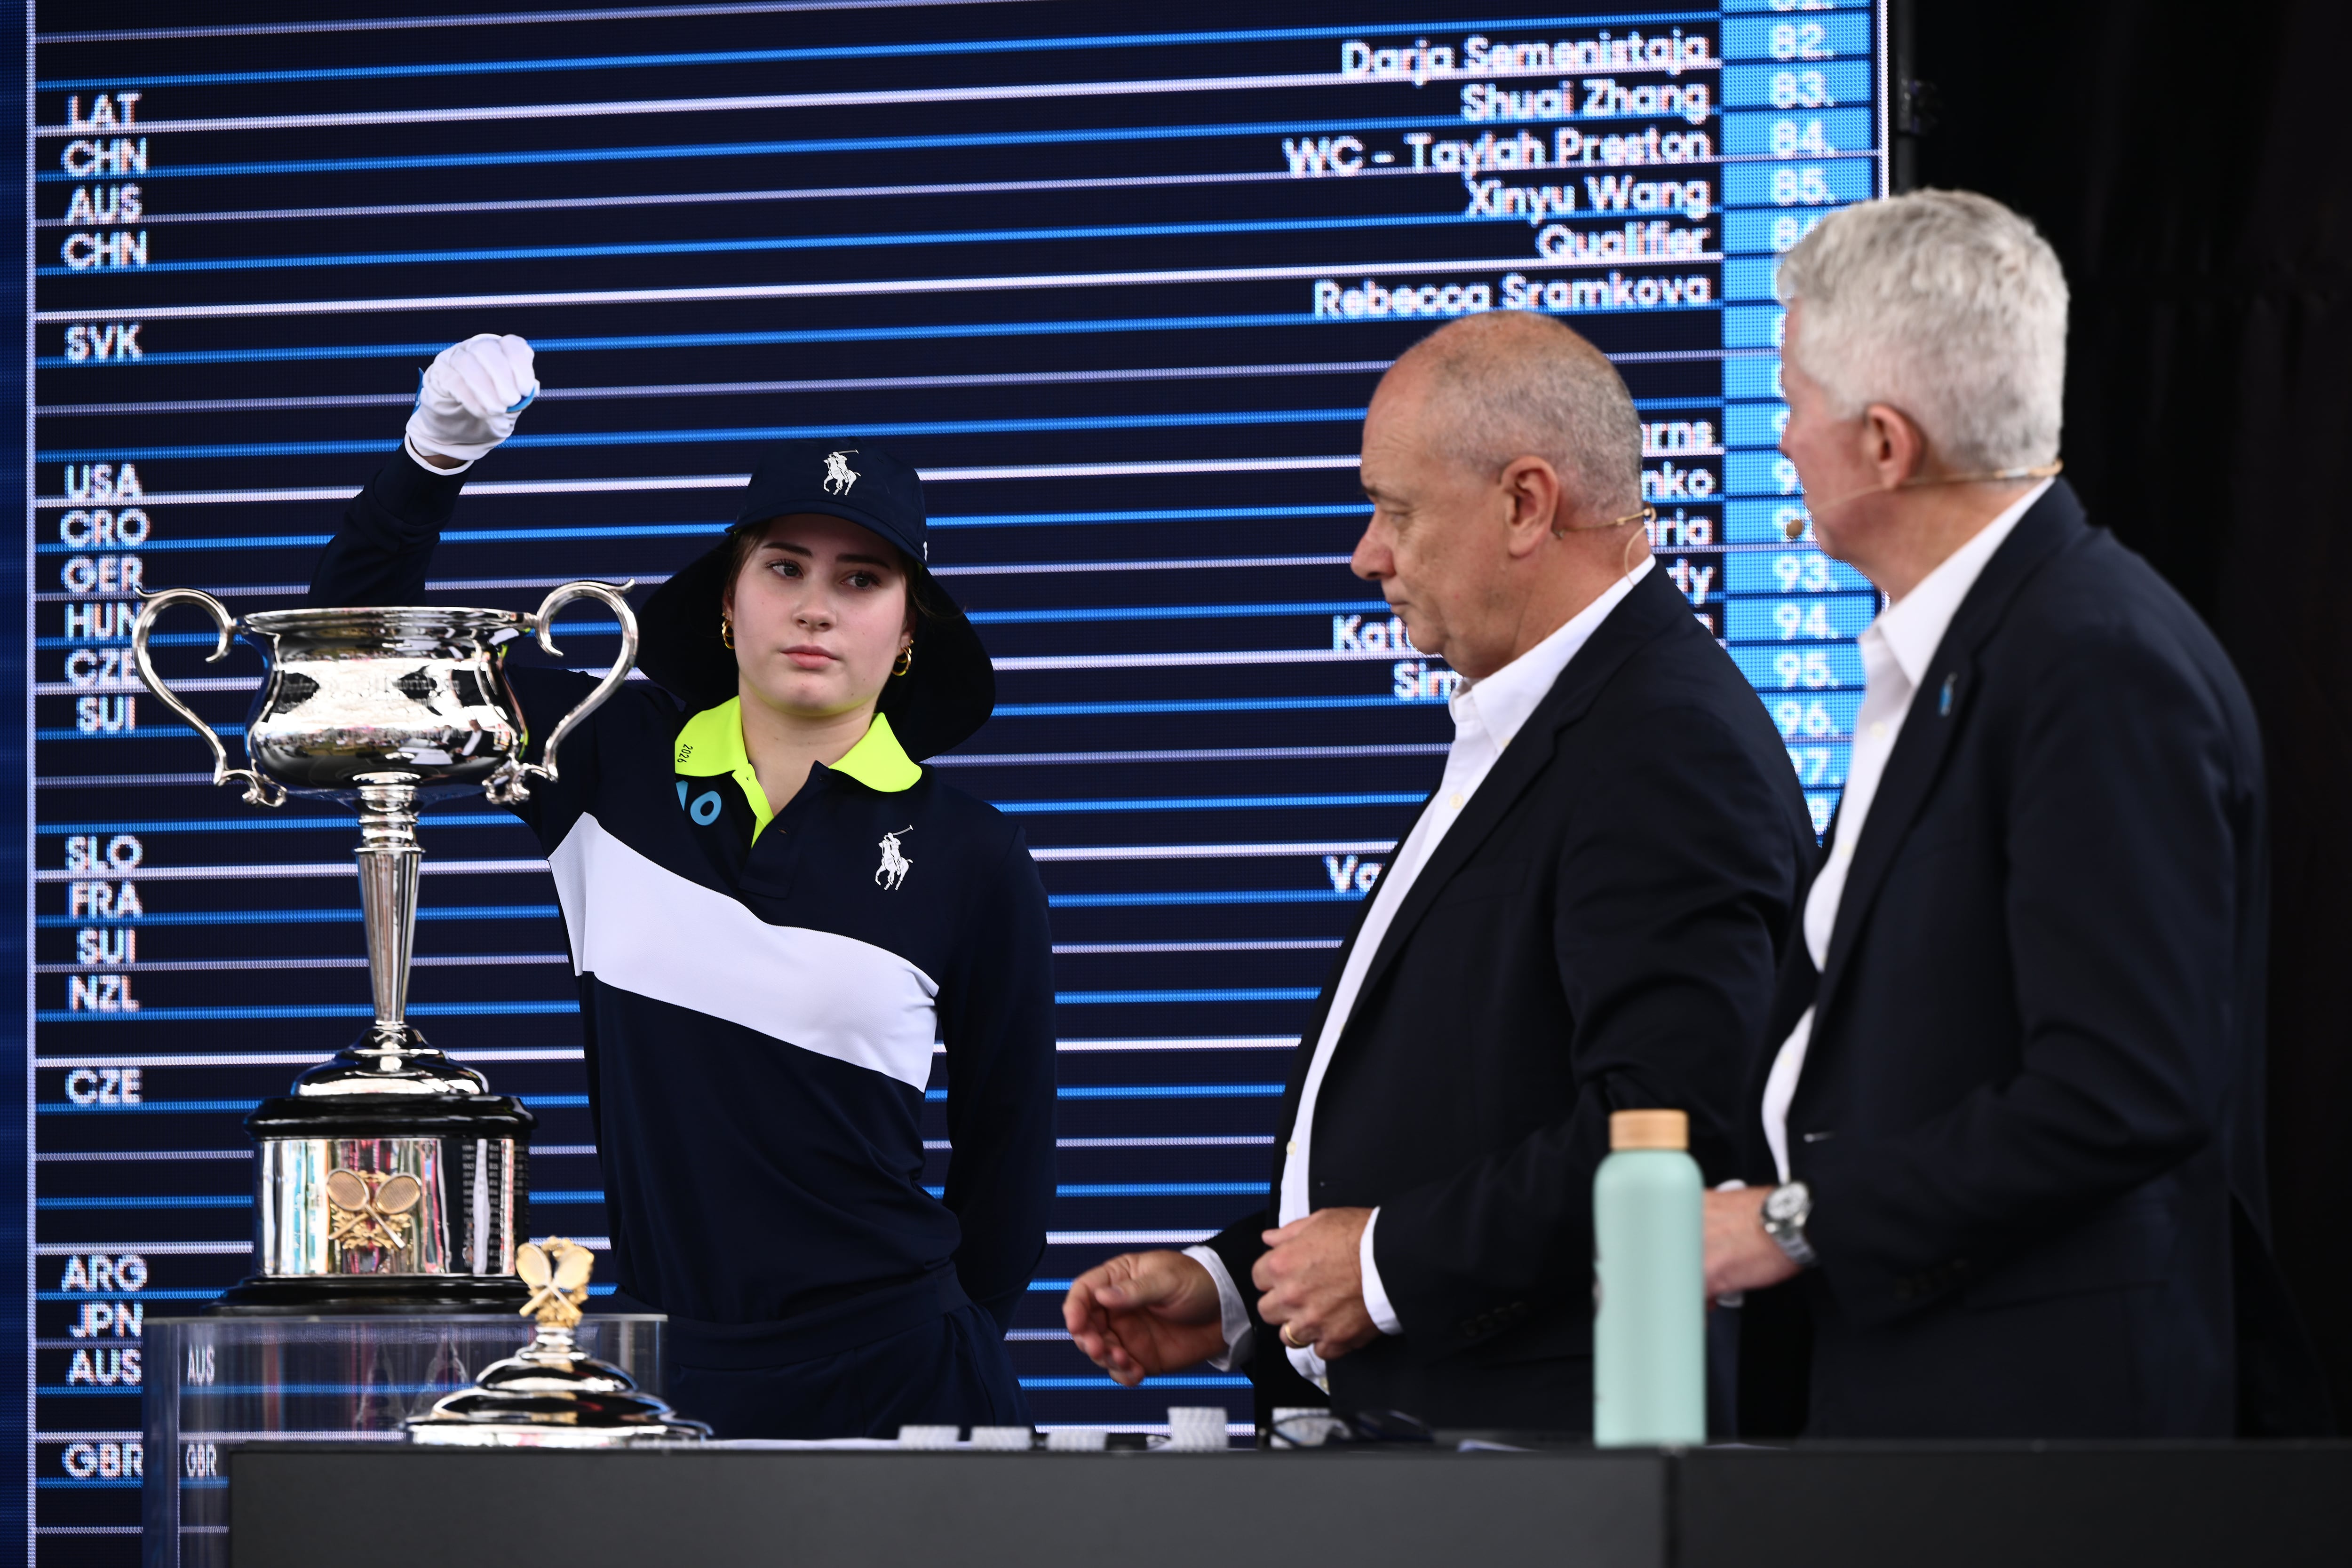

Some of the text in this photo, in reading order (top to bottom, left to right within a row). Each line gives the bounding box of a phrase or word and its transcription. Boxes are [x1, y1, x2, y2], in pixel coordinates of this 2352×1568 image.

[1342, 27, 1710, 87] Darja Semenistaja
[68, 90, 142, 129] LAT
[1461, 79, 1710, 125] Shuai Zhang
[62, 137, 150, 176] CHN
[1281, 135, 1366, 178] WC
[1403, 129, 1546, 181] Taylah
[1556, 125, 1714, 167] Preston
[64, 183, 143, 226] AUS
[1466, 174, 1711, 227] Xinyu Wang
[62, 230, 150, 270] CHN
[1535, 220, 1711, 259] Qualifier
[1314, 270, 1711, 319] Rebecca Sramkova
[65, 324, 143, 364] SVK
[65, 463, 143, 499] USA
[1641, 461, 1716, 500] nko
[61, 508, 151, 547] CRO
[61, 554, 144, 593] GER
[65, 602, 146, 641] HUN
[1333, 614, 1412, 652] Kat
[1394, 659, 1464, 701] Sim
[76, 696, 136, 734] SUI
[677, 744, 693, 763] 2026
[65, 835, 143, 871] SLO
[1322, 850, 1386, 893] Va
[66, 881, 143, 919] FRA
[76, 927, 135, 964] SUI
[66, 975, 140, 1012] NZL
[65, 1069, 143, 1104] CZE
[62, 1255, 147, 1291] ARG
[67, 1301, 143, 1338] JPN
[66, 1349, 142, 1386] AUS
[62, 1443, 143, 1478] GBR
